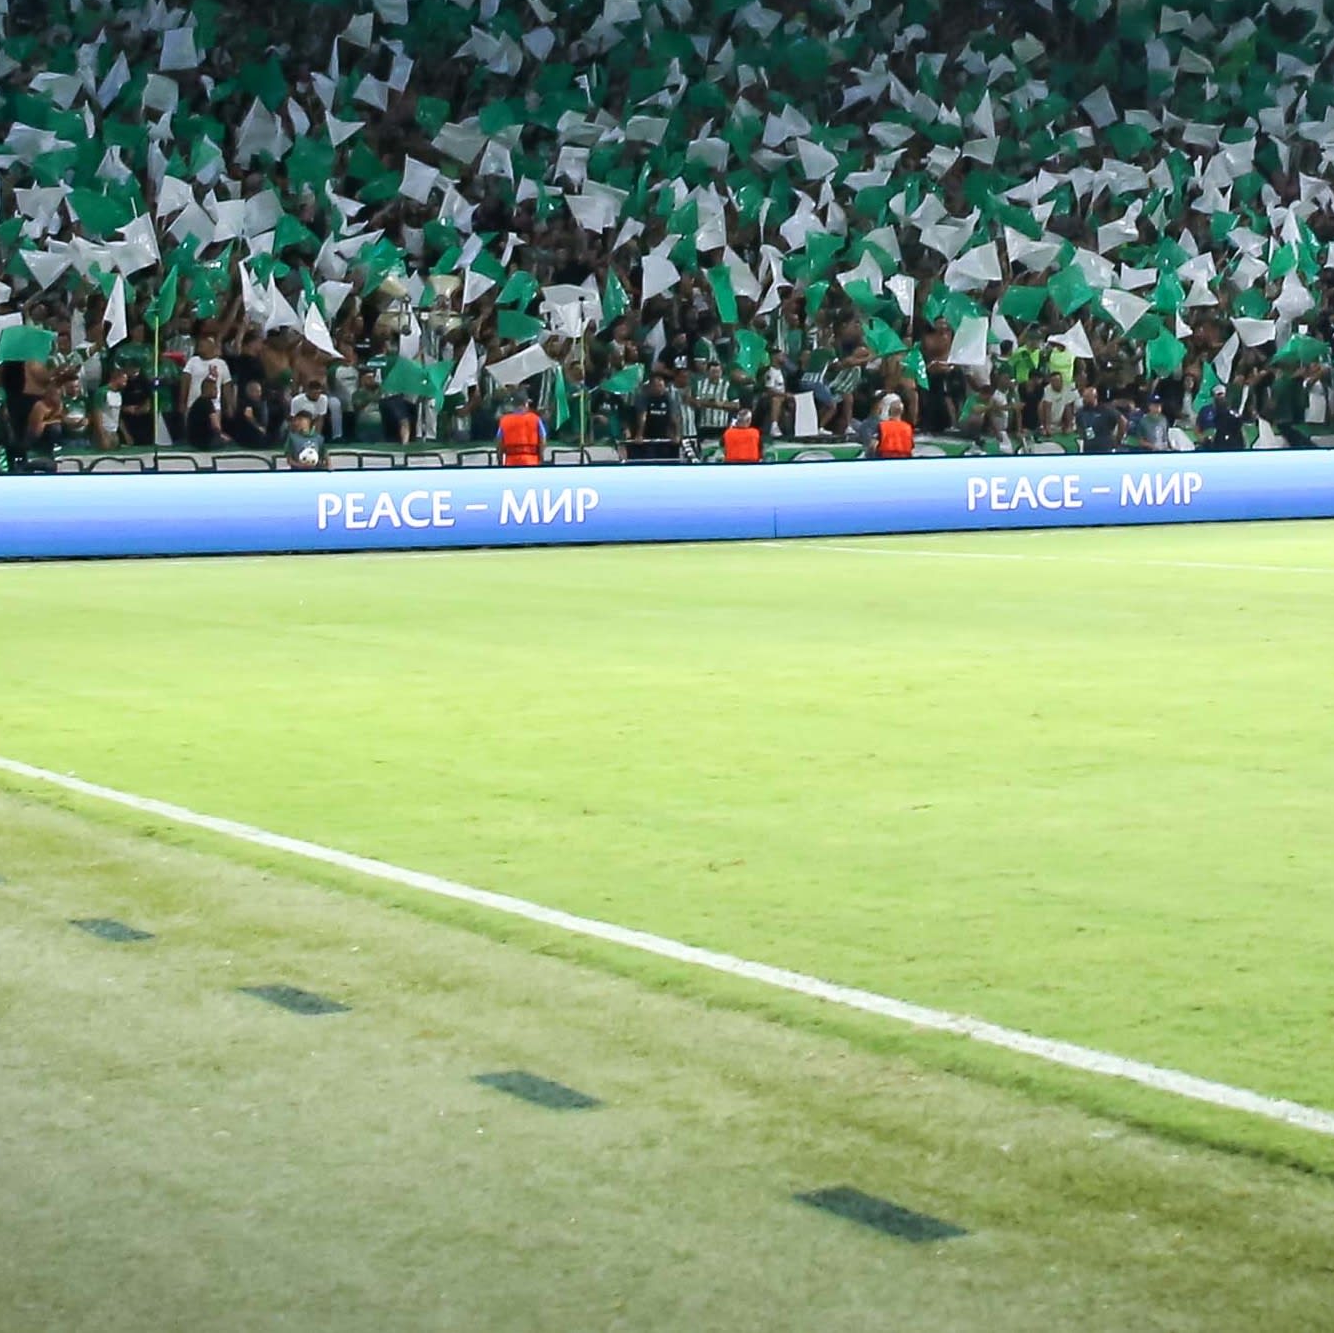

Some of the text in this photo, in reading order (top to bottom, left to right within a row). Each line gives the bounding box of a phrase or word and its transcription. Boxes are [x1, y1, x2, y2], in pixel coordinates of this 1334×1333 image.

[317, 490, 454, 529] PEACE
[500, 487, 600, 525] МИР
[967, 474, 1083, 511] PEACE
[1120, 471, 1203, 506] МИР
